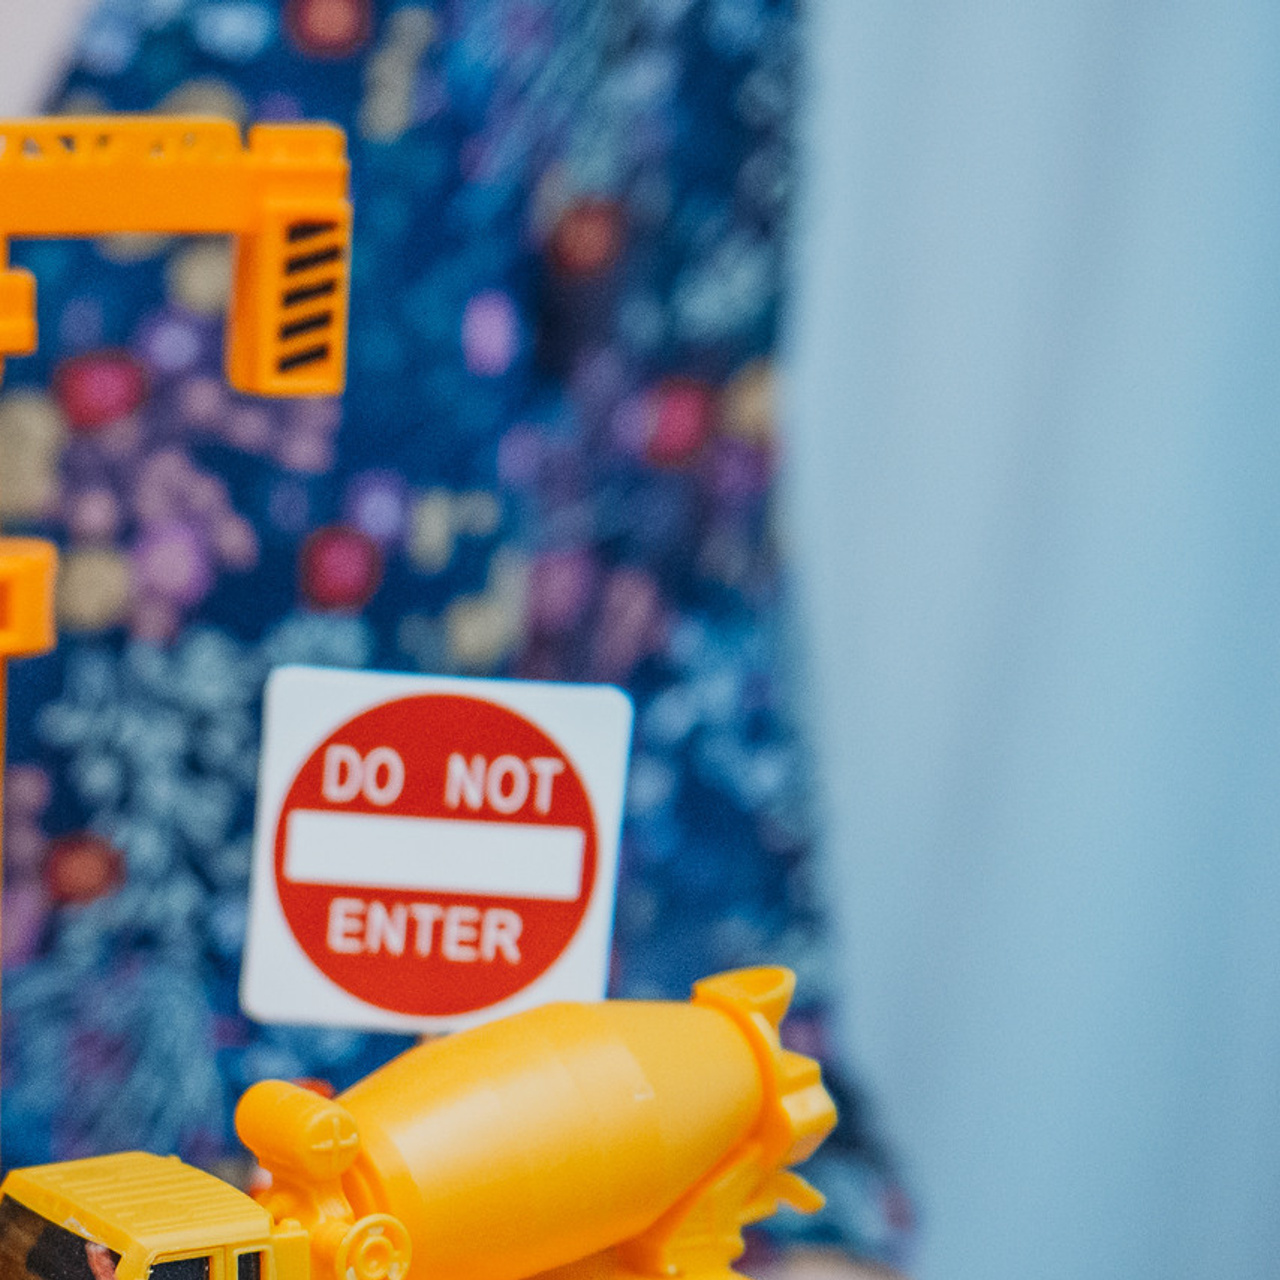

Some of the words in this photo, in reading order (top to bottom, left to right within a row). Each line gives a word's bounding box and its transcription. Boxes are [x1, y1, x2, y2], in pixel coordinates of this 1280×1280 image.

[322, 743, 406, 806] DO
[444, 751, 565, 817] NOT
[326, 896, 524, 965] ENTER
